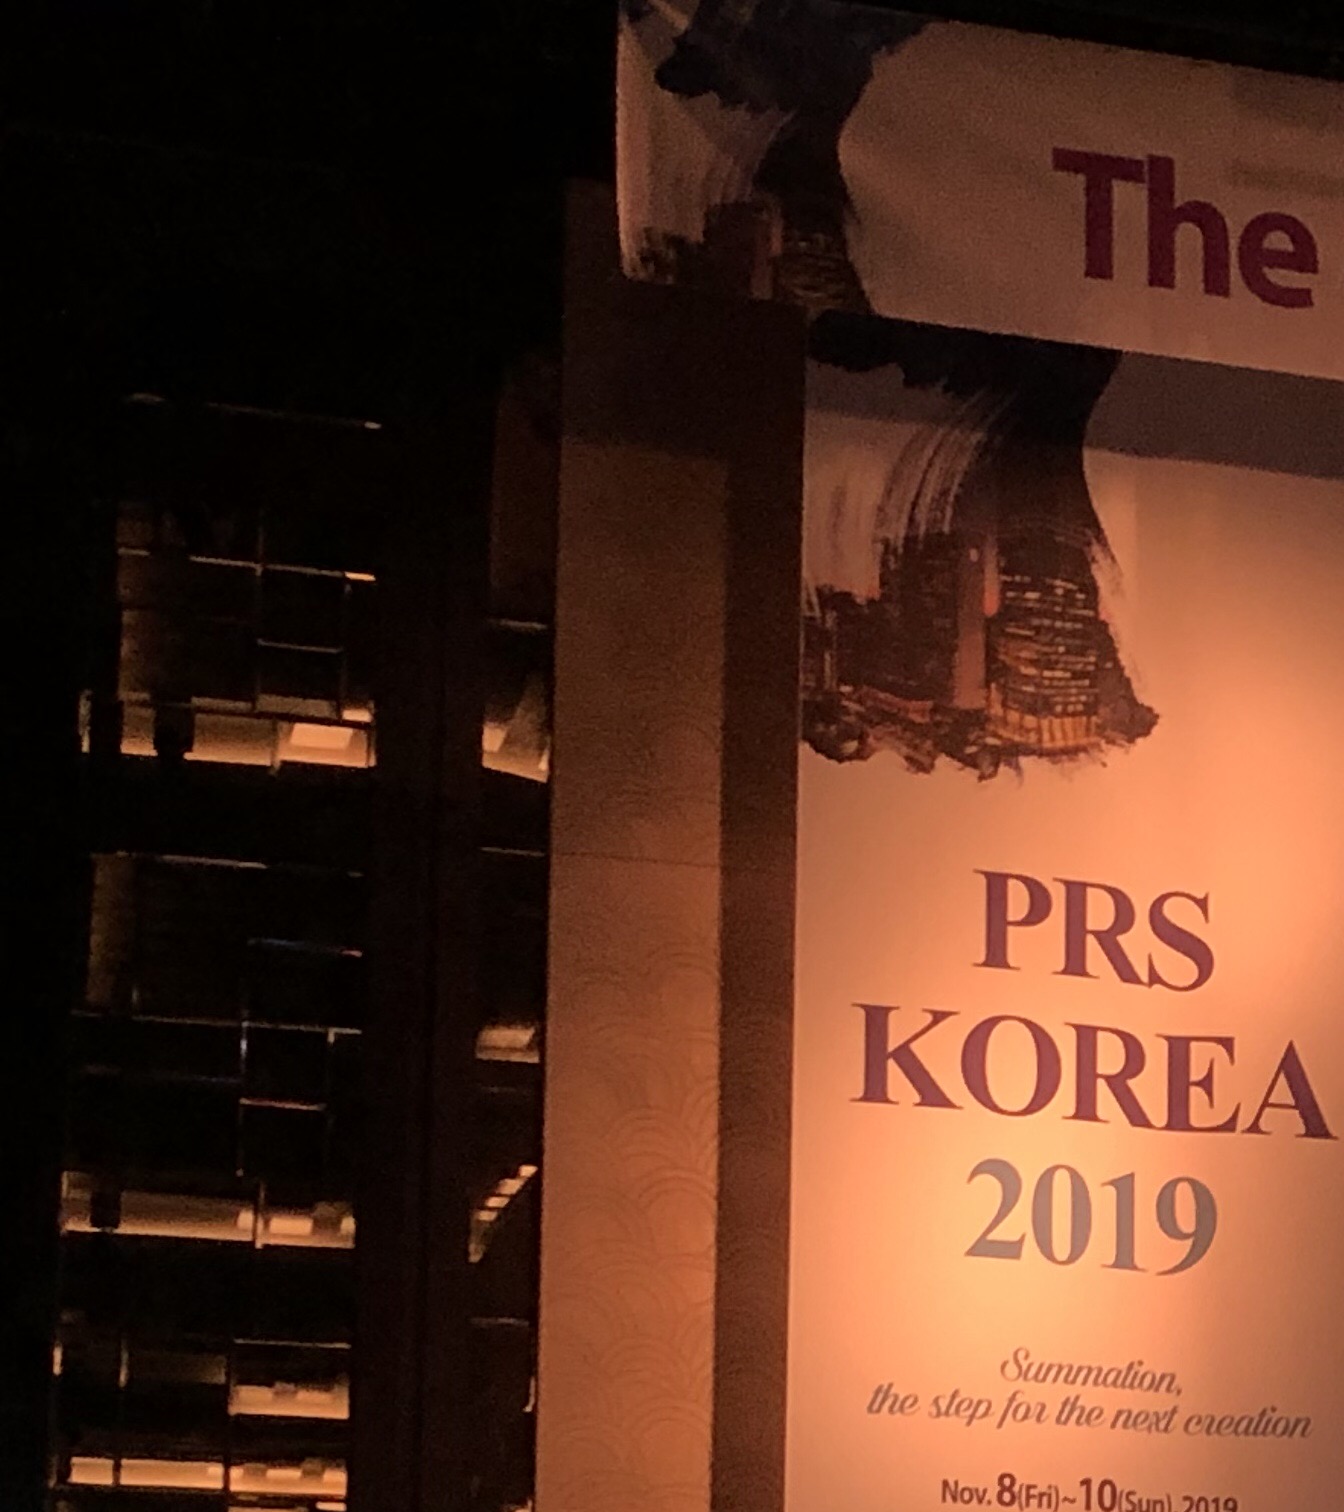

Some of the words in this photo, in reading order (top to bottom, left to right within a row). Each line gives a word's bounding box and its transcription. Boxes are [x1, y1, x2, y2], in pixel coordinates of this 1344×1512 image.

[1052, 147, 1319, 309] The
[973, 869, 1214, 992] PRS
[849, 1002, 1339, 1141] KOREA
[964, 1158, 1218, 1276] 2019
[866, 1383, 920, 1417] the
[928, 1388, 993, 1427] step
[995, 1390, 1051, 1430] for
[1055, 1395, 1106, 1430] the
[1110, 1404, 1179, 1435] next
[1183, 1405, 1313, 1440] creation
[1000, 1346, 1182, 1396] Summation,
[940, 1478, 992, 1507] Nov.
